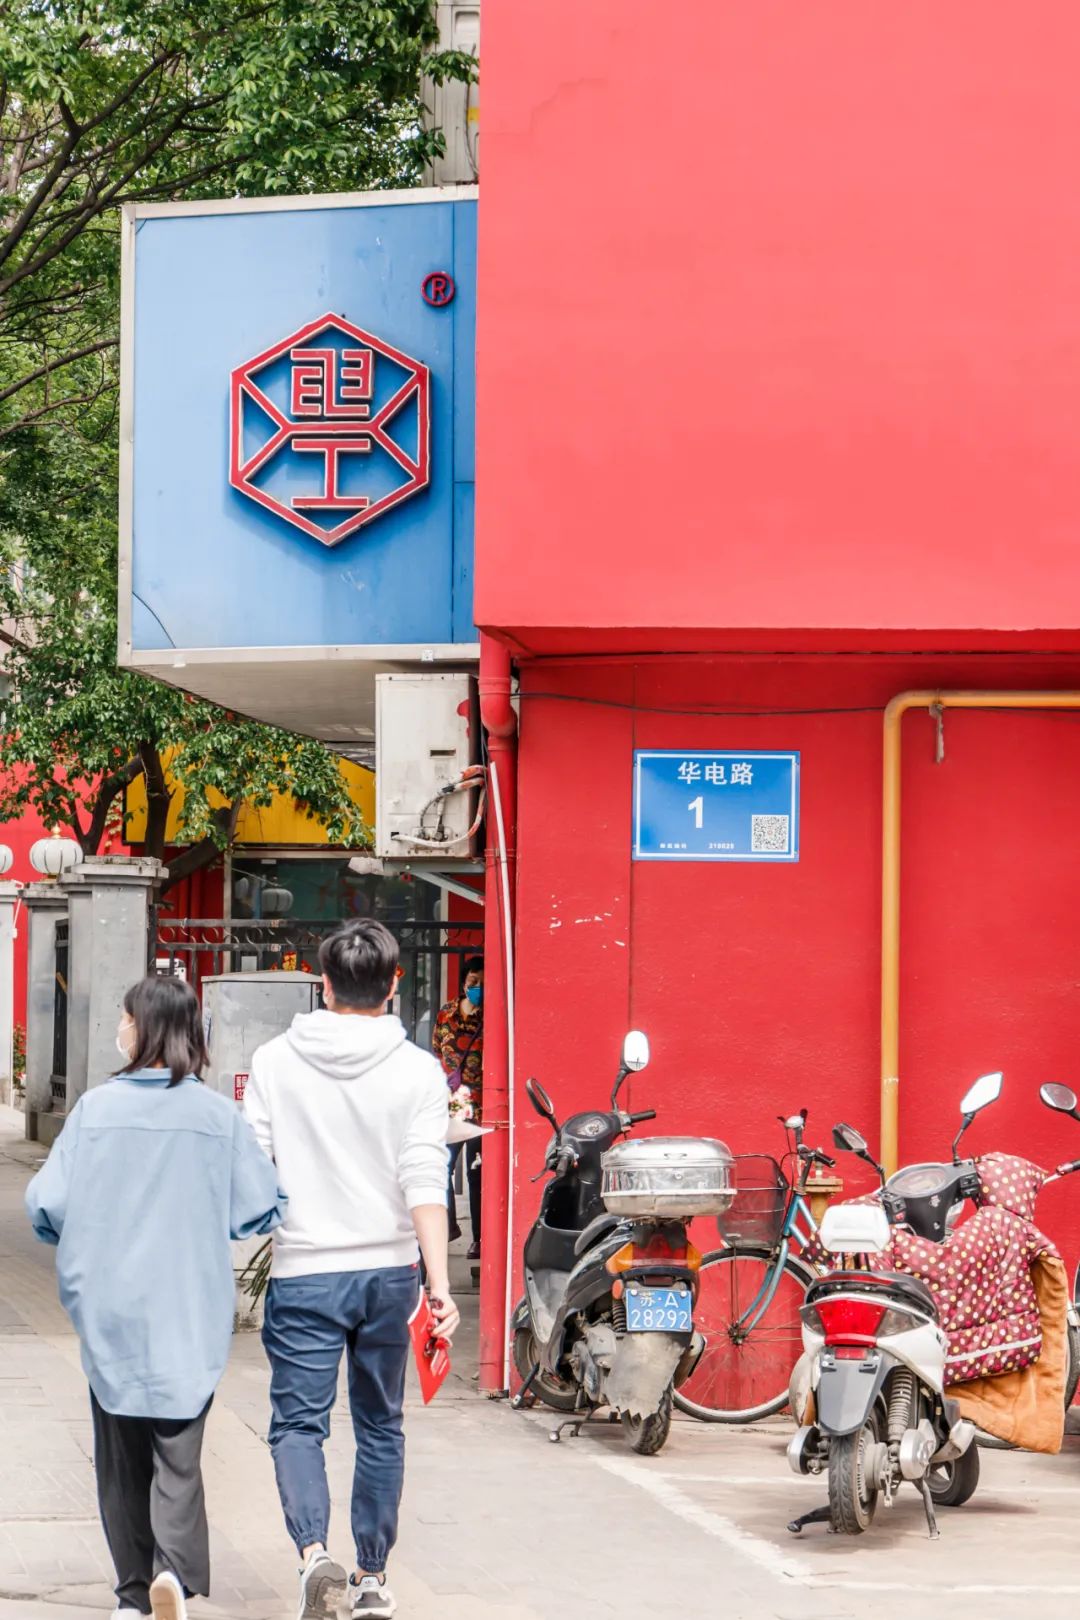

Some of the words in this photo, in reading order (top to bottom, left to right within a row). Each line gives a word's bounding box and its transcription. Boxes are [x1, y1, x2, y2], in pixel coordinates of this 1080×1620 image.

[677, 761, 754, 785] 华电路
[687, 795, 704, 829] 1
[631, 1309, 689, 1329] 28292
